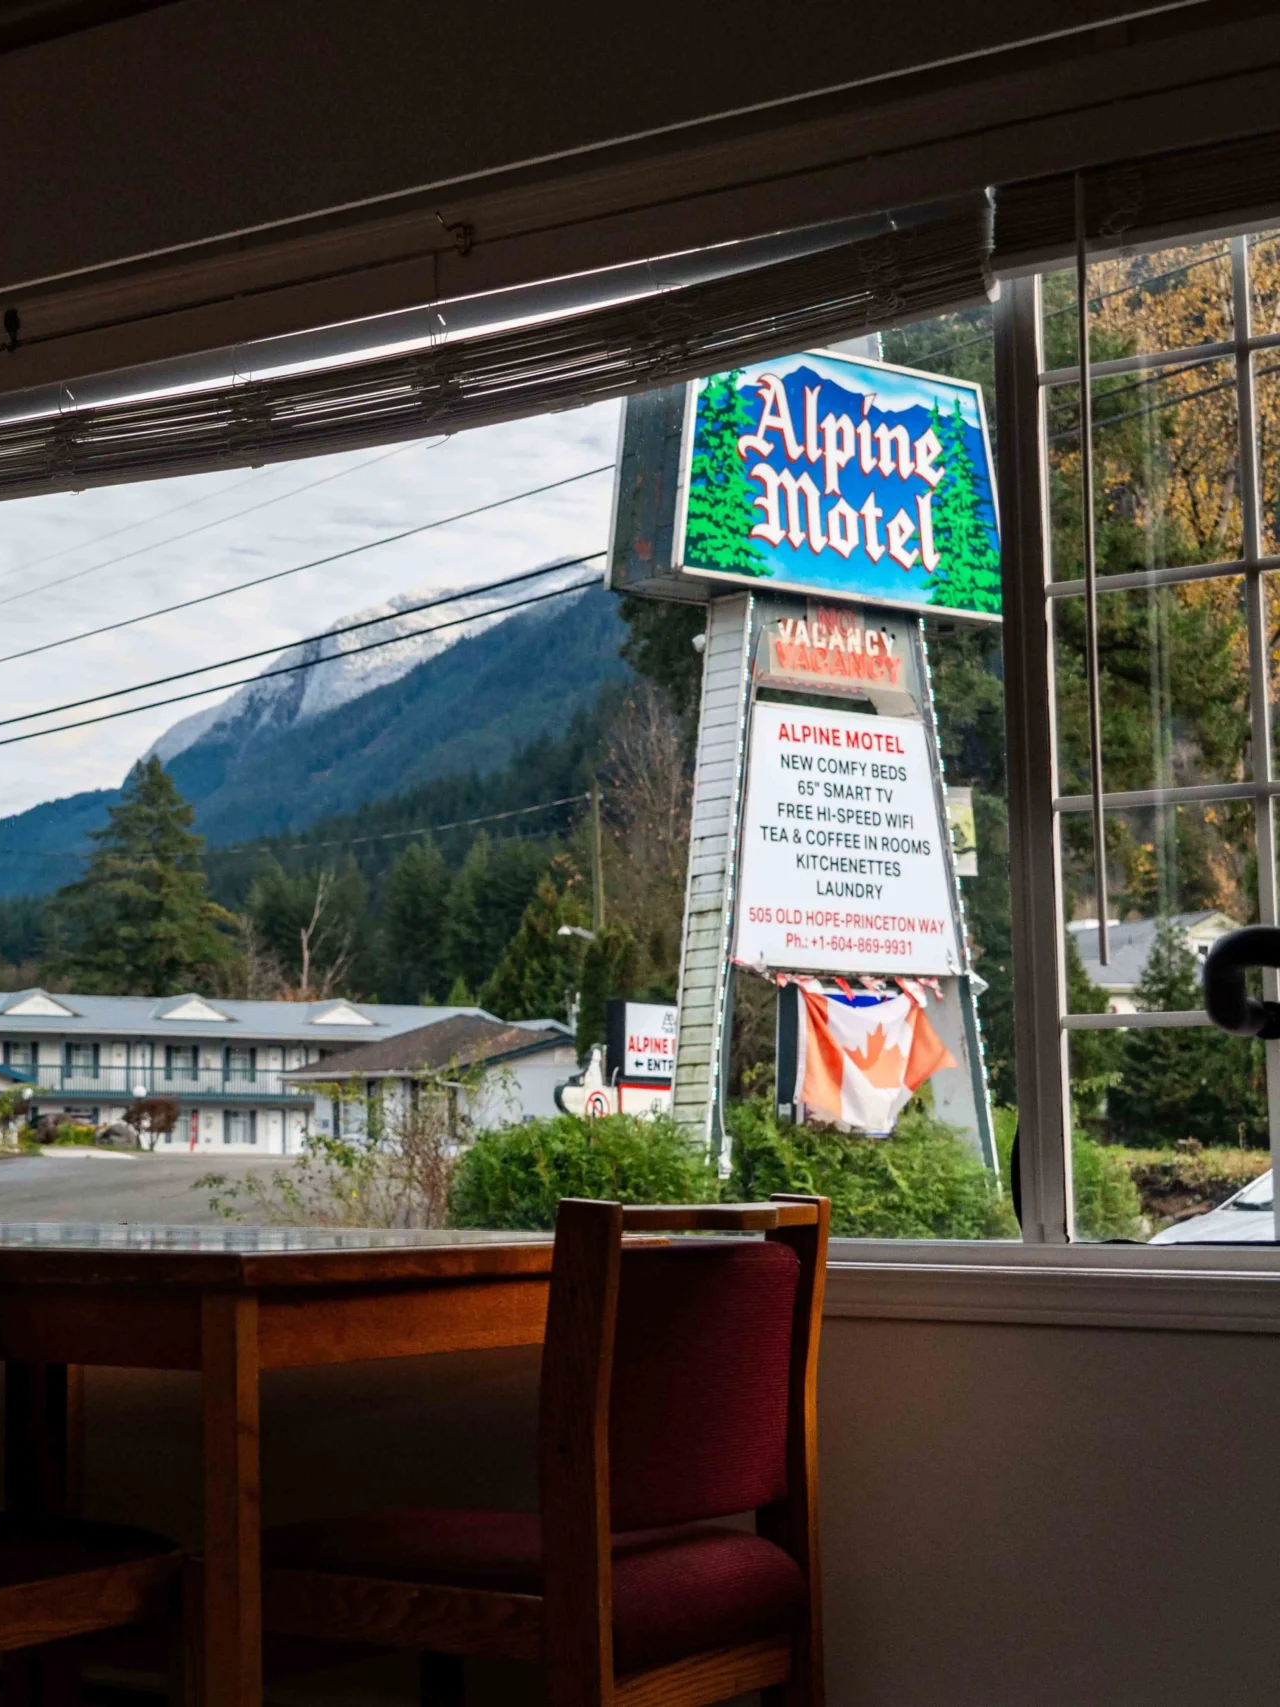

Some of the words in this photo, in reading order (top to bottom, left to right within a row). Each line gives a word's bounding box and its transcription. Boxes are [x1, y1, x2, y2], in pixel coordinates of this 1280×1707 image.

[737, 373, 946, 496] Alpine
[749, 463, 941, 573] Motel
[777, 618, 895, 657] VACANCY
[775, 640, 900, 685] VACANCY
[778, 723, 841, 747] ALPINE
[846, 730, 905, 754] MOTEL
[780, 753, 813, 771] NEW
[817, 757, 867, 777] COMFY
[871, 763, 907, 782] BEDS
[823, 783, 873, 801] SMART
[875, 787, 893, 804] TV
[777, 802, 813, 820] FREE
[817, 806, 881, 827] HI-SPEED
[885, 814, 914, 830] WIFI
[759, 825, 789, 843] TEA
[792, 829, 802, 844] &
[805, 830, 860, 849] COFFEE
[864, 835, 877, 850] IN
[881, 837, 931, 855] ROOMS
[796, 854, 901, 876] KITCHENETTES
[816, 880, 883, 901] LAUNDRY
[749, 907, 772, 923] 505
[776, 909, 802, 926] OLD
[805, 911, 916, 933] HOPE-PRINCETON
[919, 918, 945, 935] WAY
[811, 935, 913, 955] +1-604-869-9931
[628, 1035, 669, 1054] ALPINE
